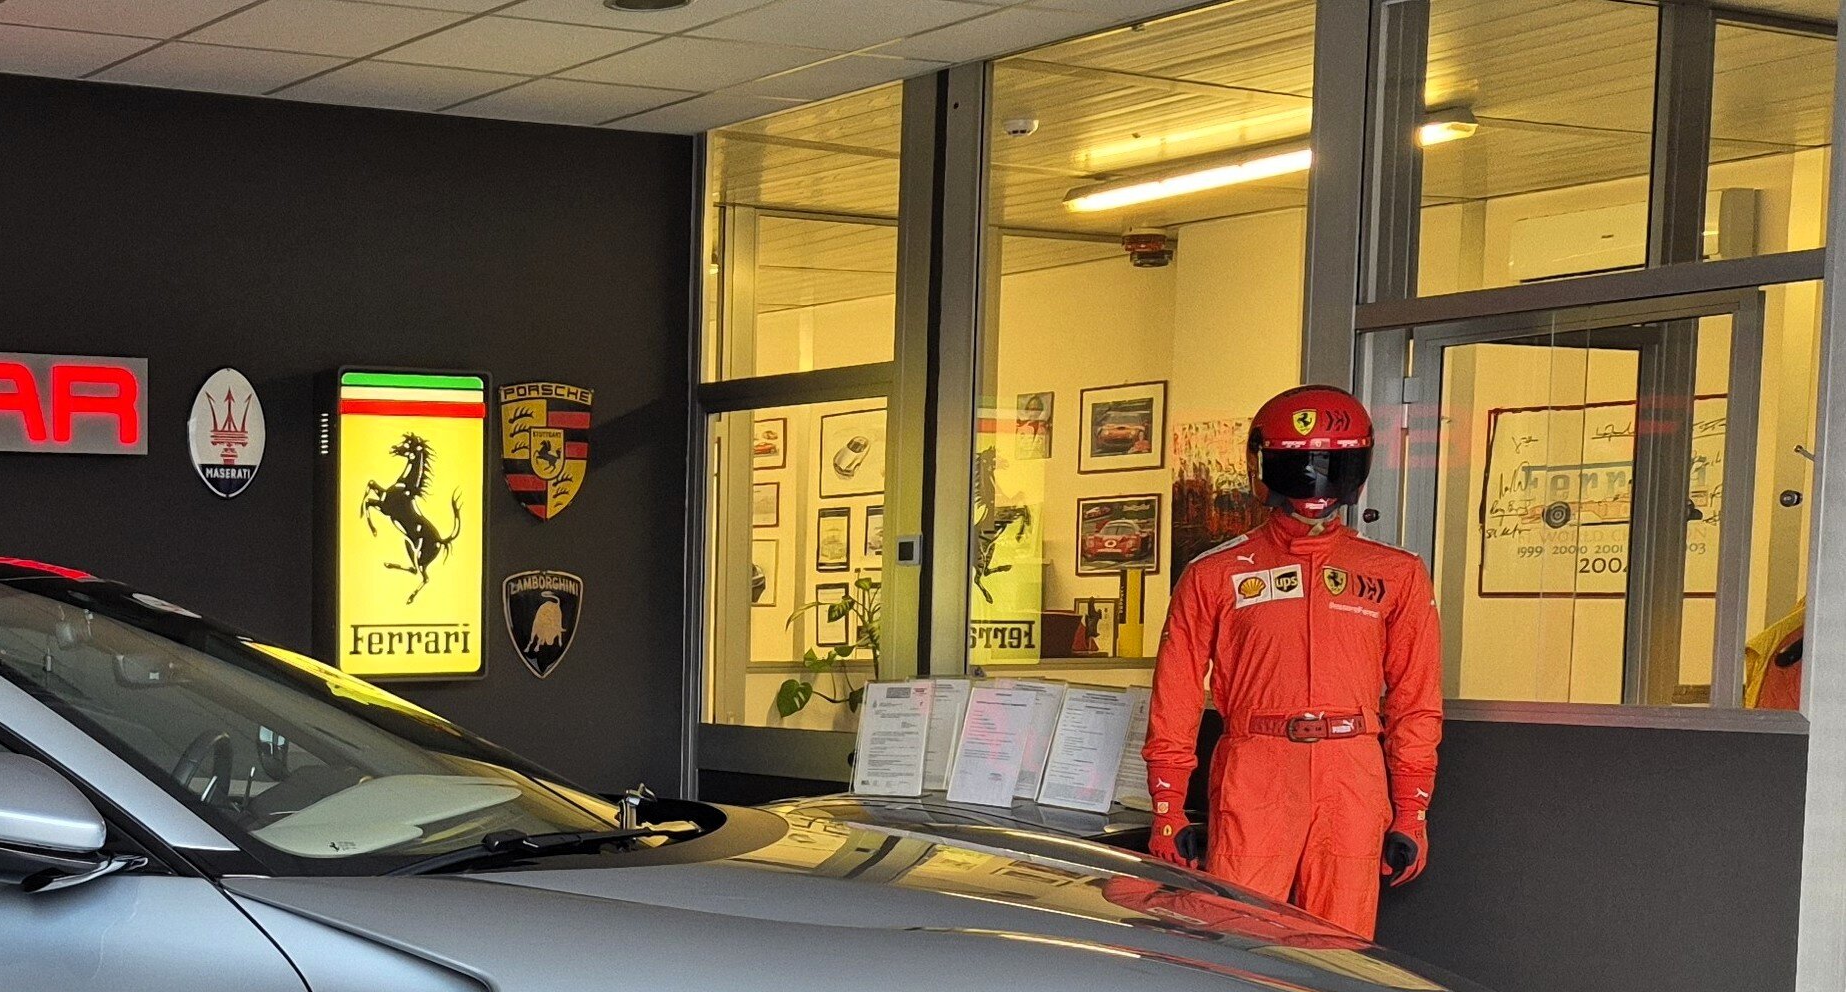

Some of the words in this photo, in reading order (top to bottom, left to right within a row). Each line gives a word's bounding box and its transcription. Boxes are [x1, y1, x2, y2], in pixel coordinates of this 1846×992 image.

[504, 384, 590, 403] PORSCHE
[205, 467, 251, 479] MASERATI
[1517, 545, 1544, 559] 1999
[1594, 544, 1623, 555] 2001
[510, 576, 580, 597] LAMBORGHINI
[1275, 576, 1299, 591] ups
[349, 623, 471, 656] Ferrari
